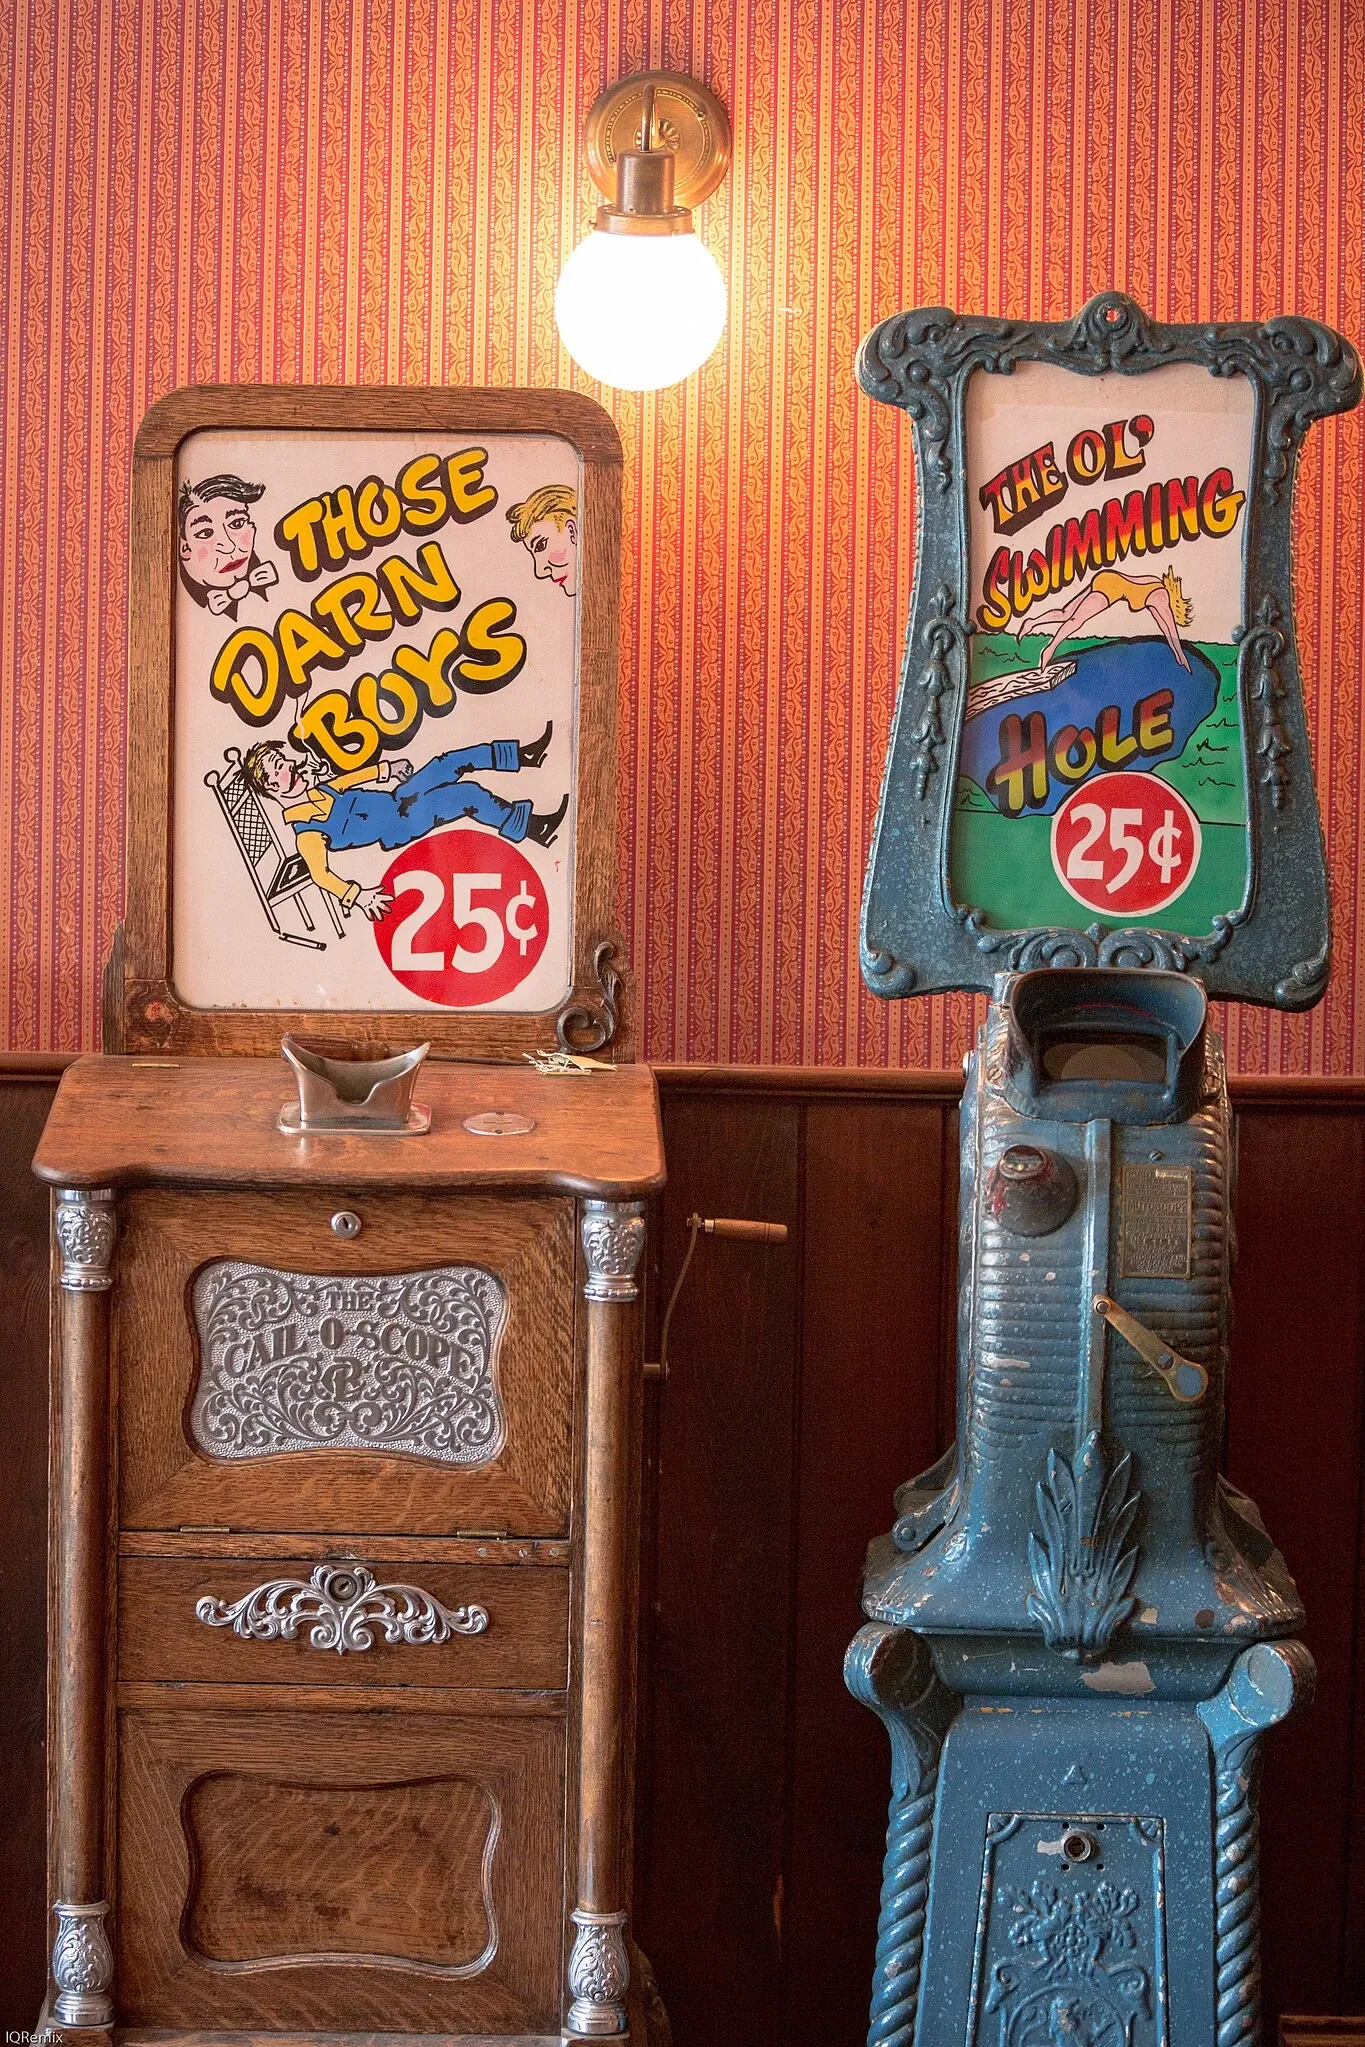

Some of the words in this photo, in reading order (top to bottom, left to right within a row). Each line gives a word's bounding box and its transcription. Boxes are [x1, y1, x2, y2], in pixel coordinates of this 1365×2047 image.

[274, 447, 499, 582] THOSE
[976, 467, 1247, 632] SWIMMING
[979, 441, 1069, 536] THE
[210, 540, 463, 727] DARN
[288, 597, 527, 776] BOYS
[986, 688, 1175, 818] HOLE
[1066, 803, 1182, 894] 25¢
[391, 870, 538, 973] 25¢
[325, 1290, 375, 1312] THE
